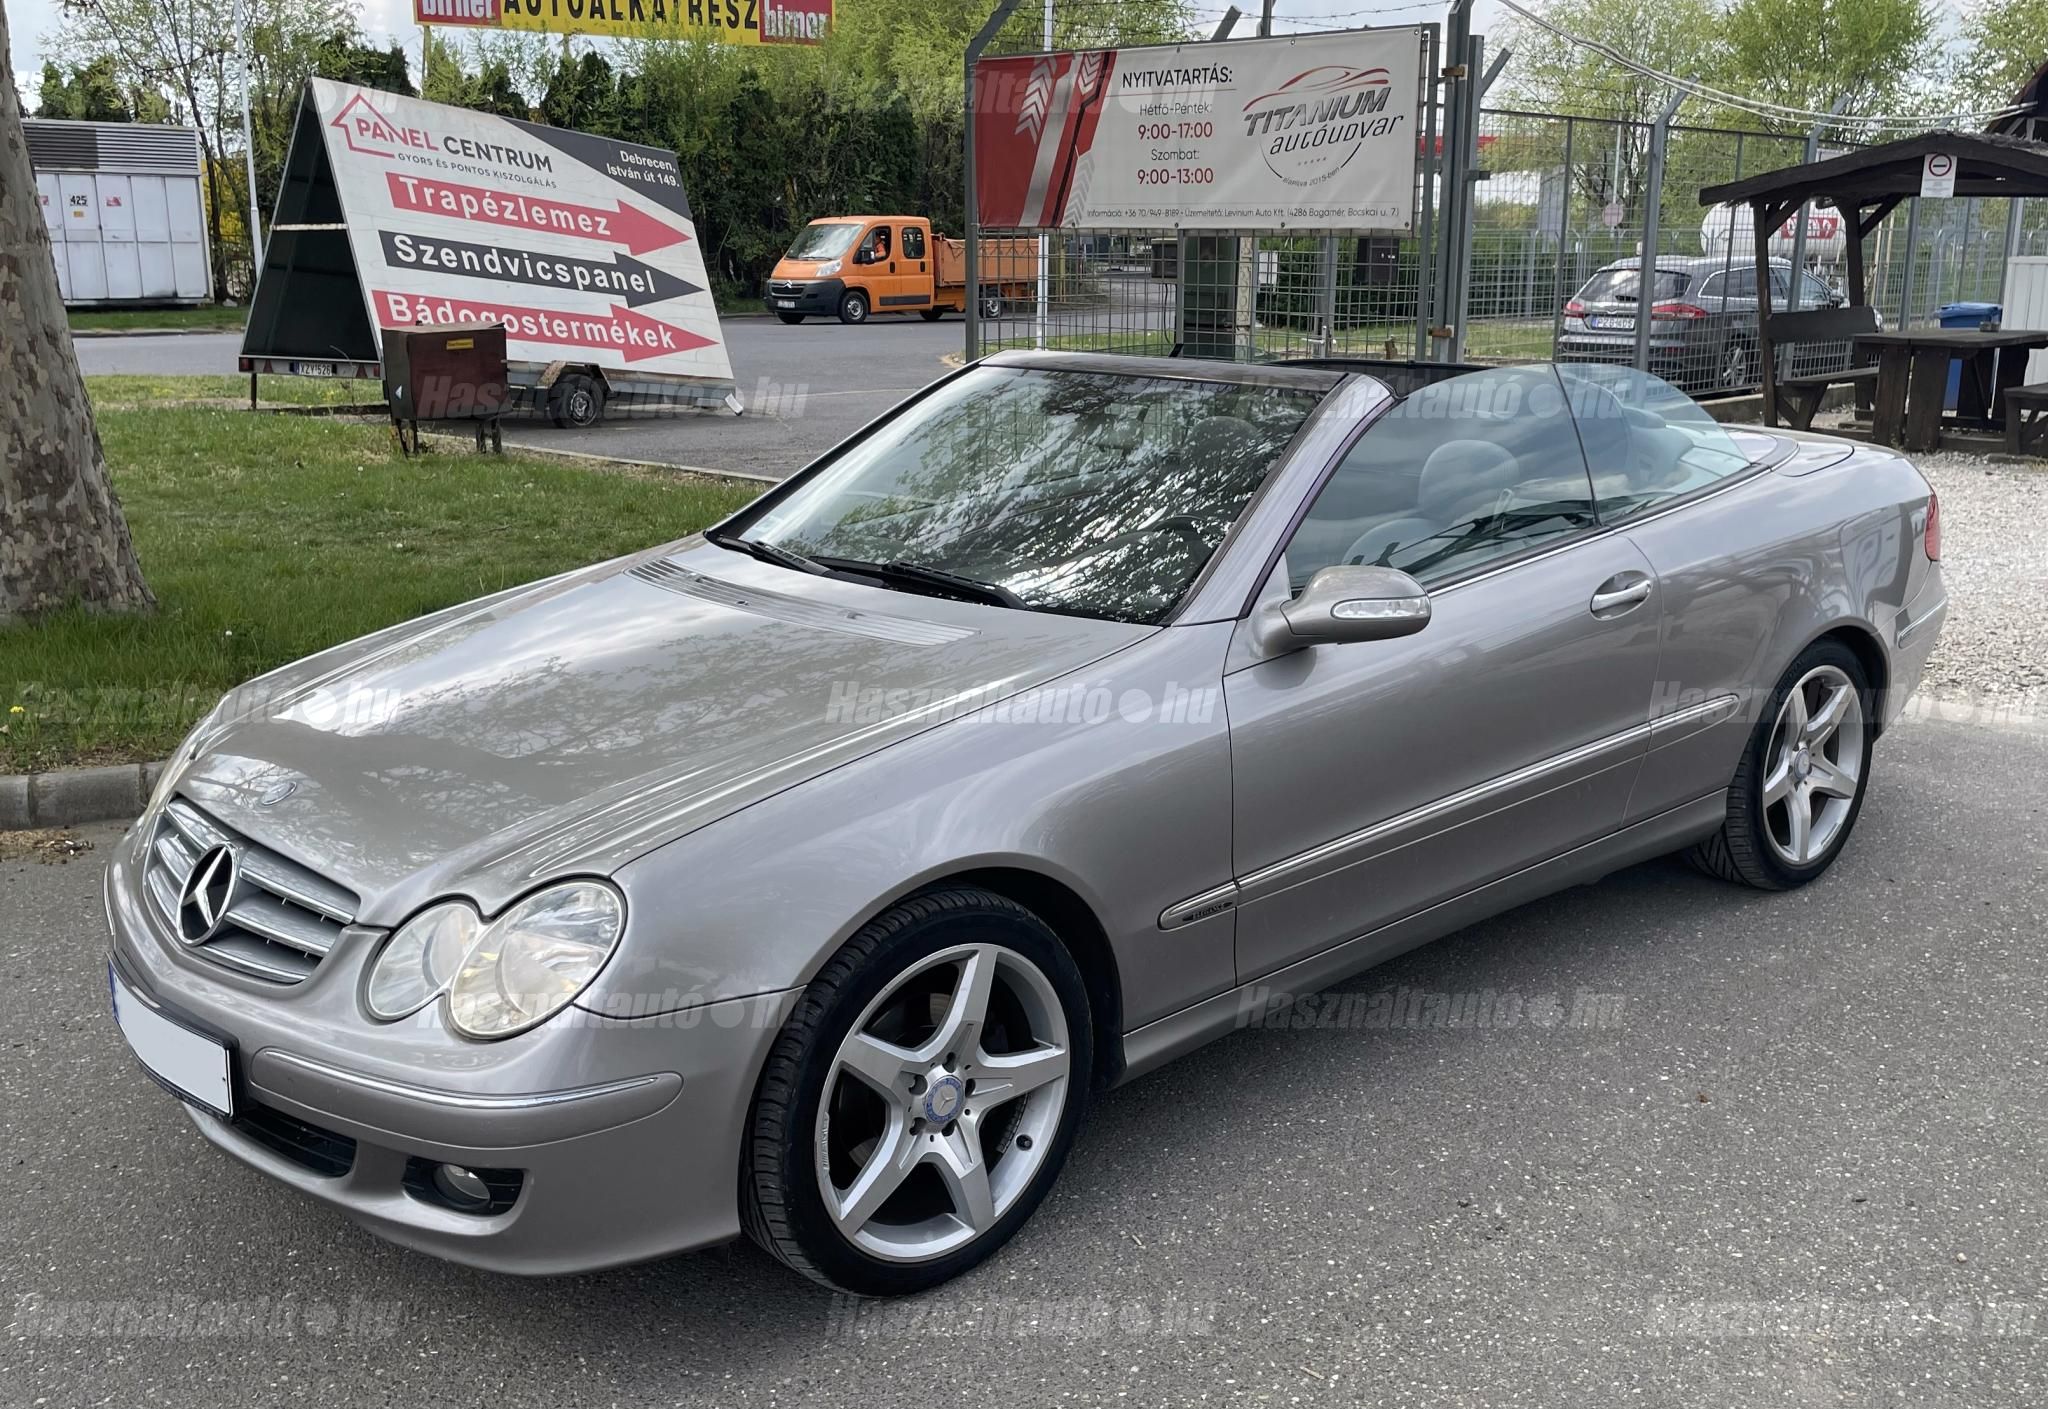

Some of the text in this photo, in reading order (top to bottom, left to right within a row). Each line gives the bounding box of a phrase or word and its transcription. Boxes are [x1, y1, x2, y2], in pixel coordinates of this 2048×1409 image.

[1121, 62, 1233, 89] NYITVATARTÁS:
[1243, 86, 1392, 137] TITANIUM
[1137, 121, 1213, 140] 9:00-17:00
[355, 117, 553, 174] PANEL CENTRUM
[1150, 148, 1200, 161] Szombat:
[398, 152, 557, 189] GYORS ÉS PONTOS KISZOLGÁLÁS
[619, 150, 677, 174] Debrecen,
[606, 163, 681, 188] István út 149.
[1137, 167, 1214, 185] 9:00-13:00
[69, 195, 88, 206] 425
[398, 175, 612, 236] Trapézlemez
[393, 234, 656, 294] Szendvicspanel
